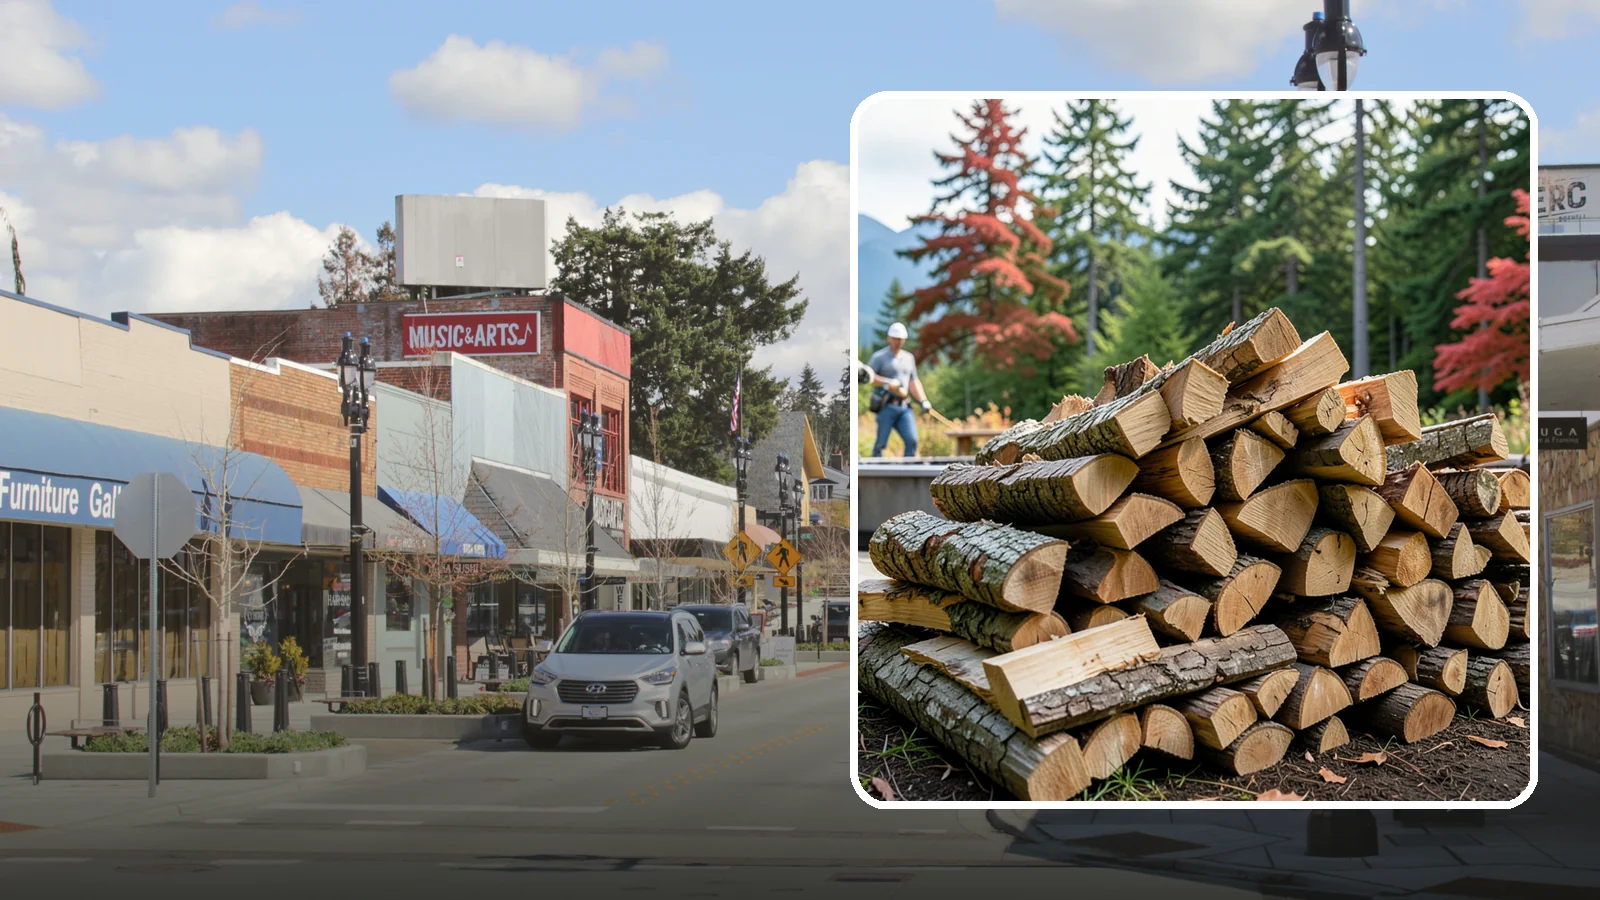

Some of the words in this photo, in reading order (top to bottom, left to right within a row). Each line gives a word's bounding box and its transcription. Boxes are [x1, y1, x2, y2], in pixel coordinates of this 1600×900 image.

[408, 323, 520, 349] MUSIC&ARTS
[0, 471, 79, 515] Furniture
[453, 563, 479, 574] SUSHI
